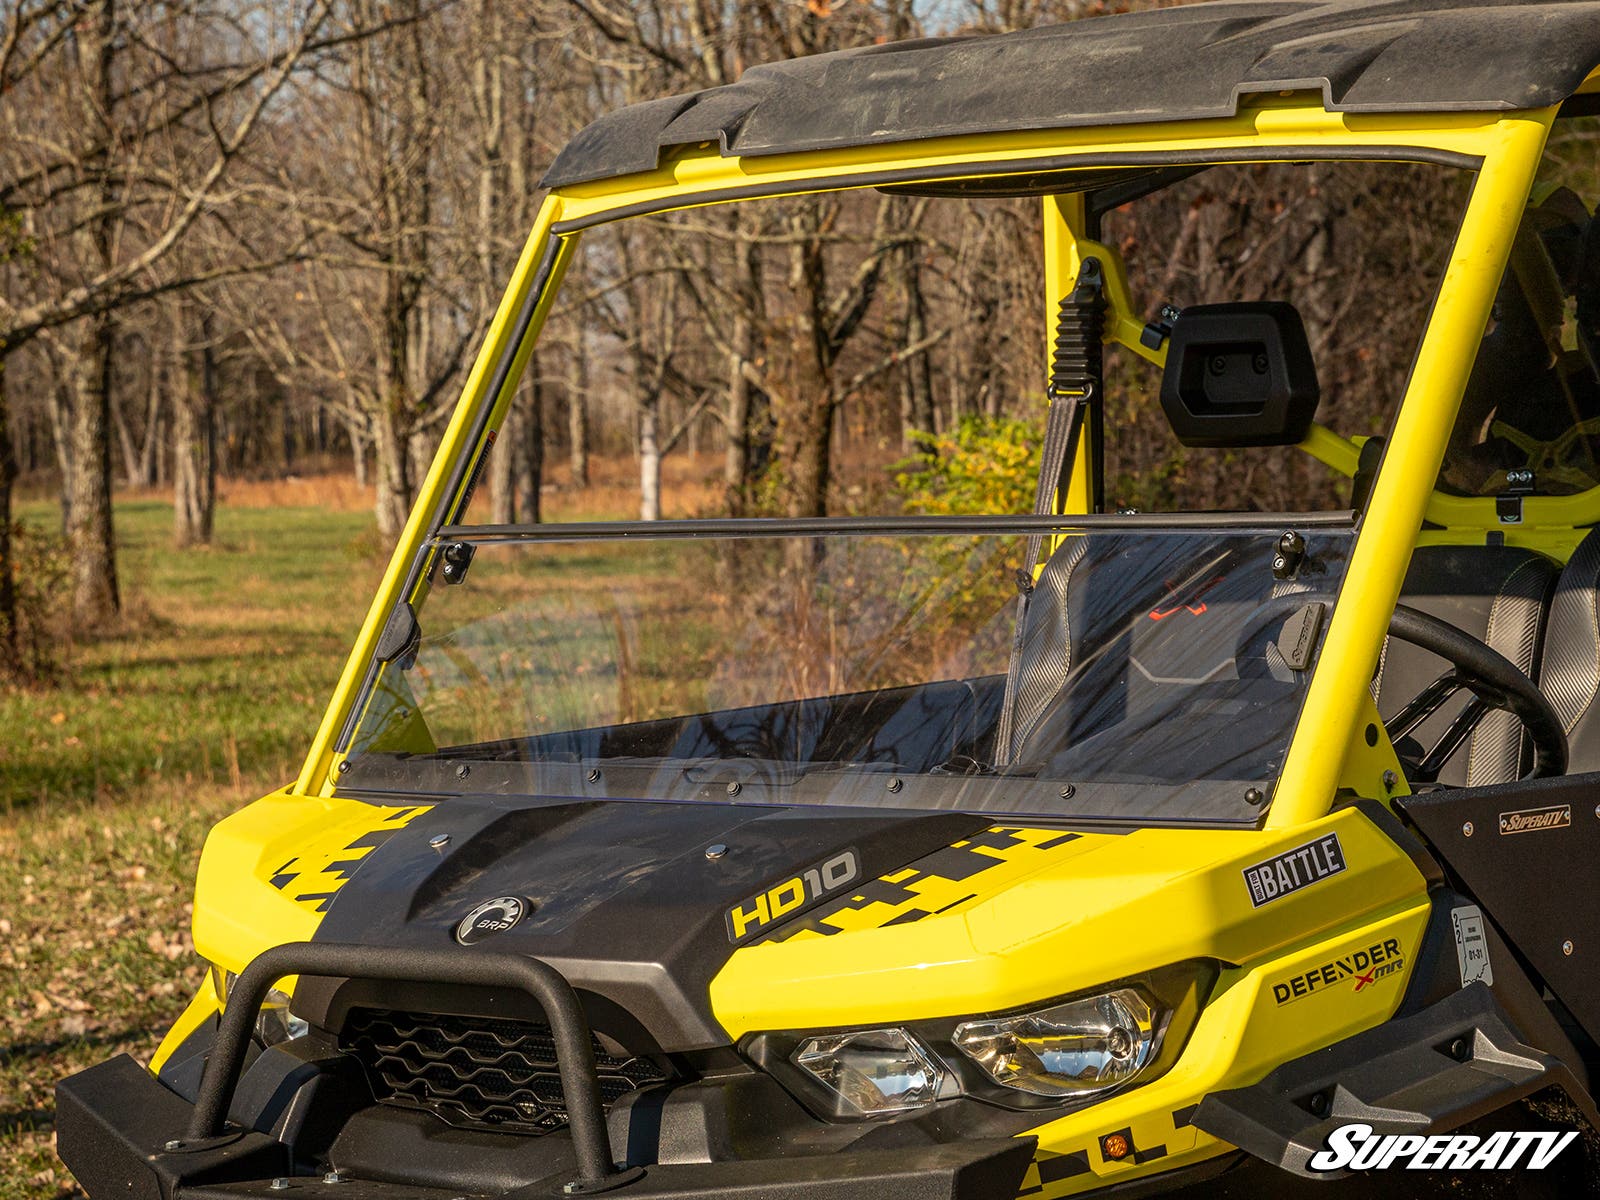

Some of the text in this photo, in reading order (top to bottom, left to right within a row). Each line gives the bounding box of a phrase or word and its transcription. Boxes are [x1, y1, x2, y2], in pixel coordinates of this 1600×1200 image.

[731, 851, 858, 939] HD10
[1258, 838, 1341, 899] BATTLE
[476, 919, 509, 931] BRP
[1273, 938, 1400, 1004] DEFENDER
